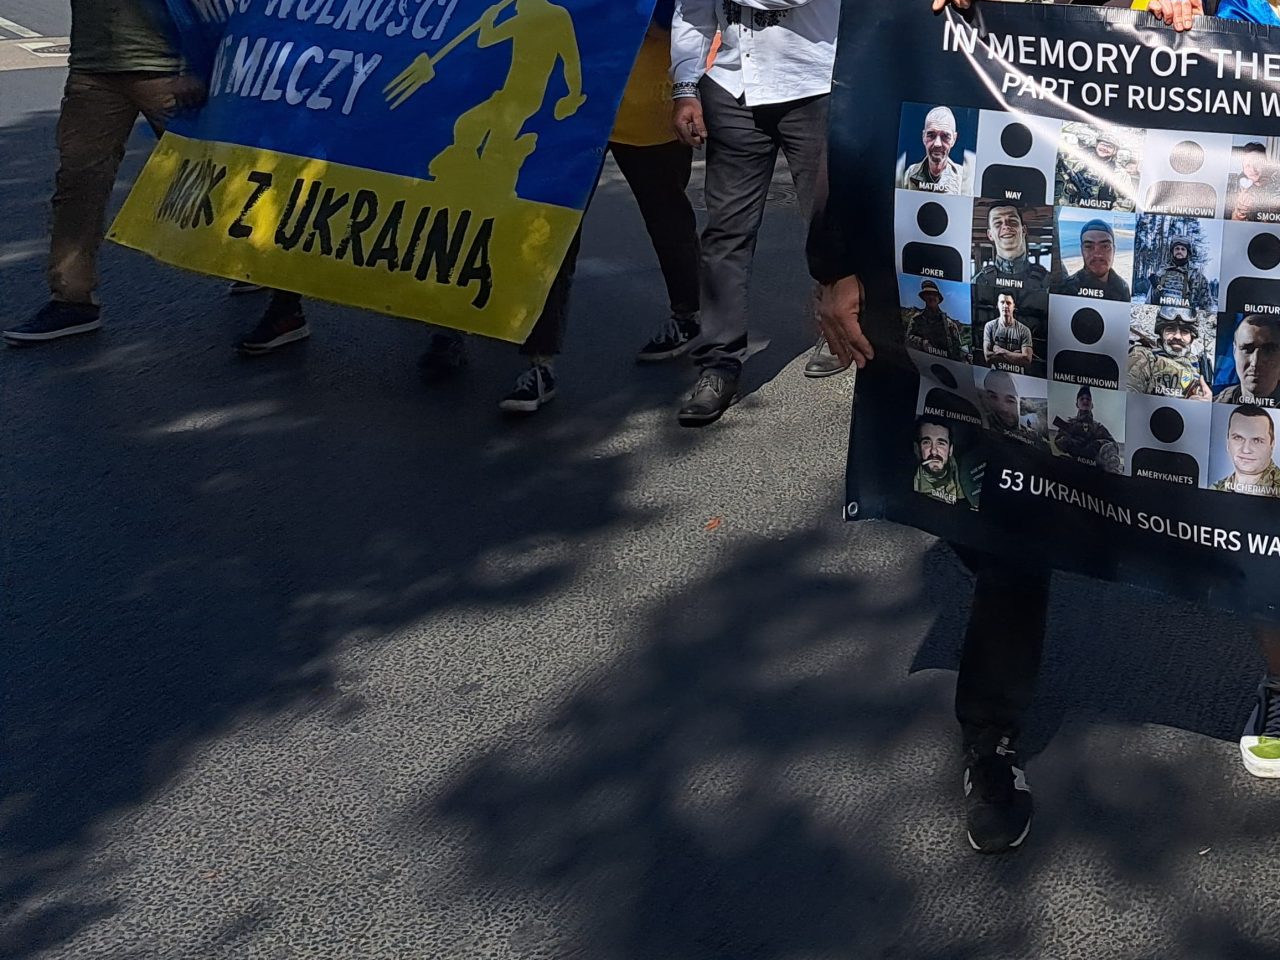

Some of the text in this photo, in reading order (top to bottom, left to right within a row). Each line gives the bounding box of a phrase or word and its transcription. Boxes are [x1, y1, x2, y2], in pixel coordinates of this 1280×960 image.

[941, 20, 978, 54] IN
[987, 33, 1143, 77] MEMORY
[1149, 45, 1200, 78] OF
[225, 36, 383, 115] MILCZY
[1001, 71, 1075, 103] PART
[1081, 82, 1120, 109] OF
[1128, 85, 1252, 116] RUSSIAN
[919, 181, 950, 193] MATROS
[1004, 190, 1023, 200] WAY
[1079, 198, 1112, 209] AUGUST
[1170, 205, 1216, 217] UNKNOWN
[227, 170, 274, 239] Z
[273, 177, 497, 310] UKRAINĄ
[920, 267, 945, 278] JOKER
[996, 278, 1024, 289] MINFIN
[1077, 287, 1105, 298] JONES
[1159, 296, 1190, 306] HRYNIA
[1244, 303, 1280, 315] BILOTUR
[997, 361, 1020, 373] SKHID
[1054, 372, 1118, 390] NAME UNKNOWN
[1154, 386, 1184, 398] RASSEL
[1238, 395, 1276, 407] GRANITE
[924, 406, 983, 427] NAME UNKNOWN
[1077, 456, 1098, 468] ADAM
[1136, 469, 1194, 485] AMERYKANETS
[931, 488, 958, 505] DANGER
[998, 468, 1025, 493] 53
[1029, 472, 1133, 527] UKRAINIAN
[1136, 511, 1242, 553] SOLDIERS
